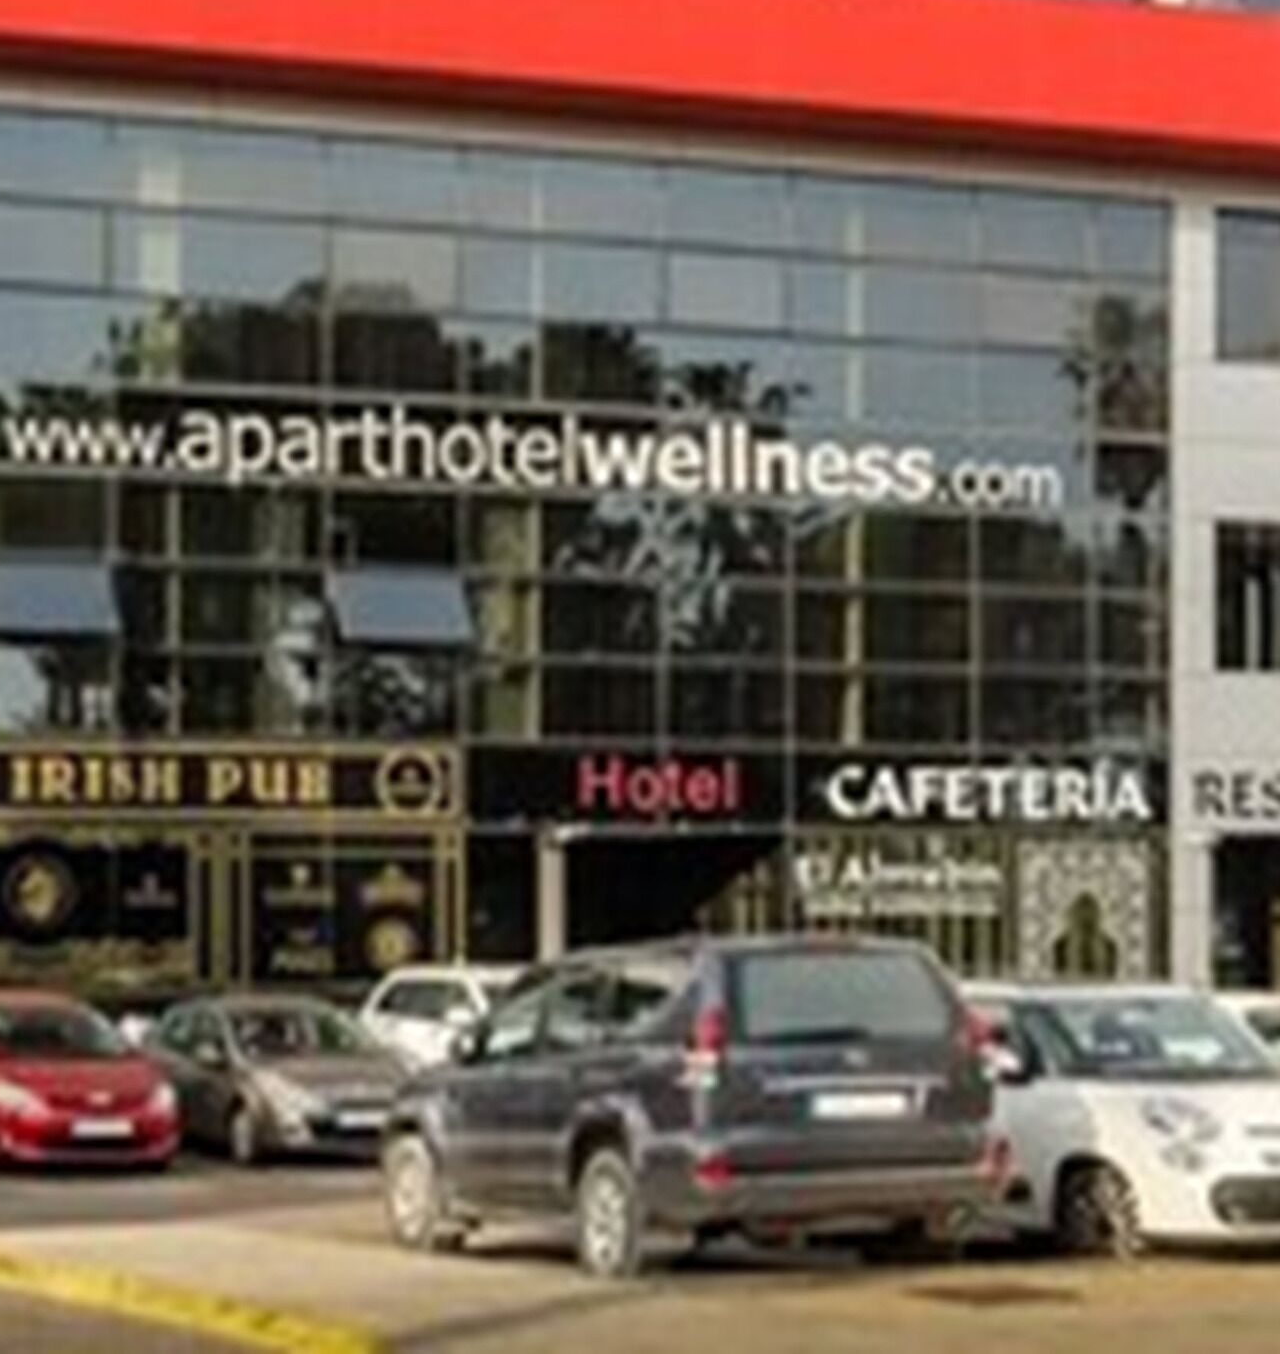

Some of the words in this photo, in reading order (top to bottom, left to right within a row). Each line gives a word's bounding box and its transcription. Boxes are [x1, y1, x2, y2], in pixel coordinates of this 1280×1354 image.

[4, 406, 1064, 510] www.aparthotelwellness.com
[9, 756, 182, 804] IRISH
[207, 758, 331, 806] PUB
[577, 756, 741, 812] Hotel
[825, 762, 1150, 822] CAFETERÍA
